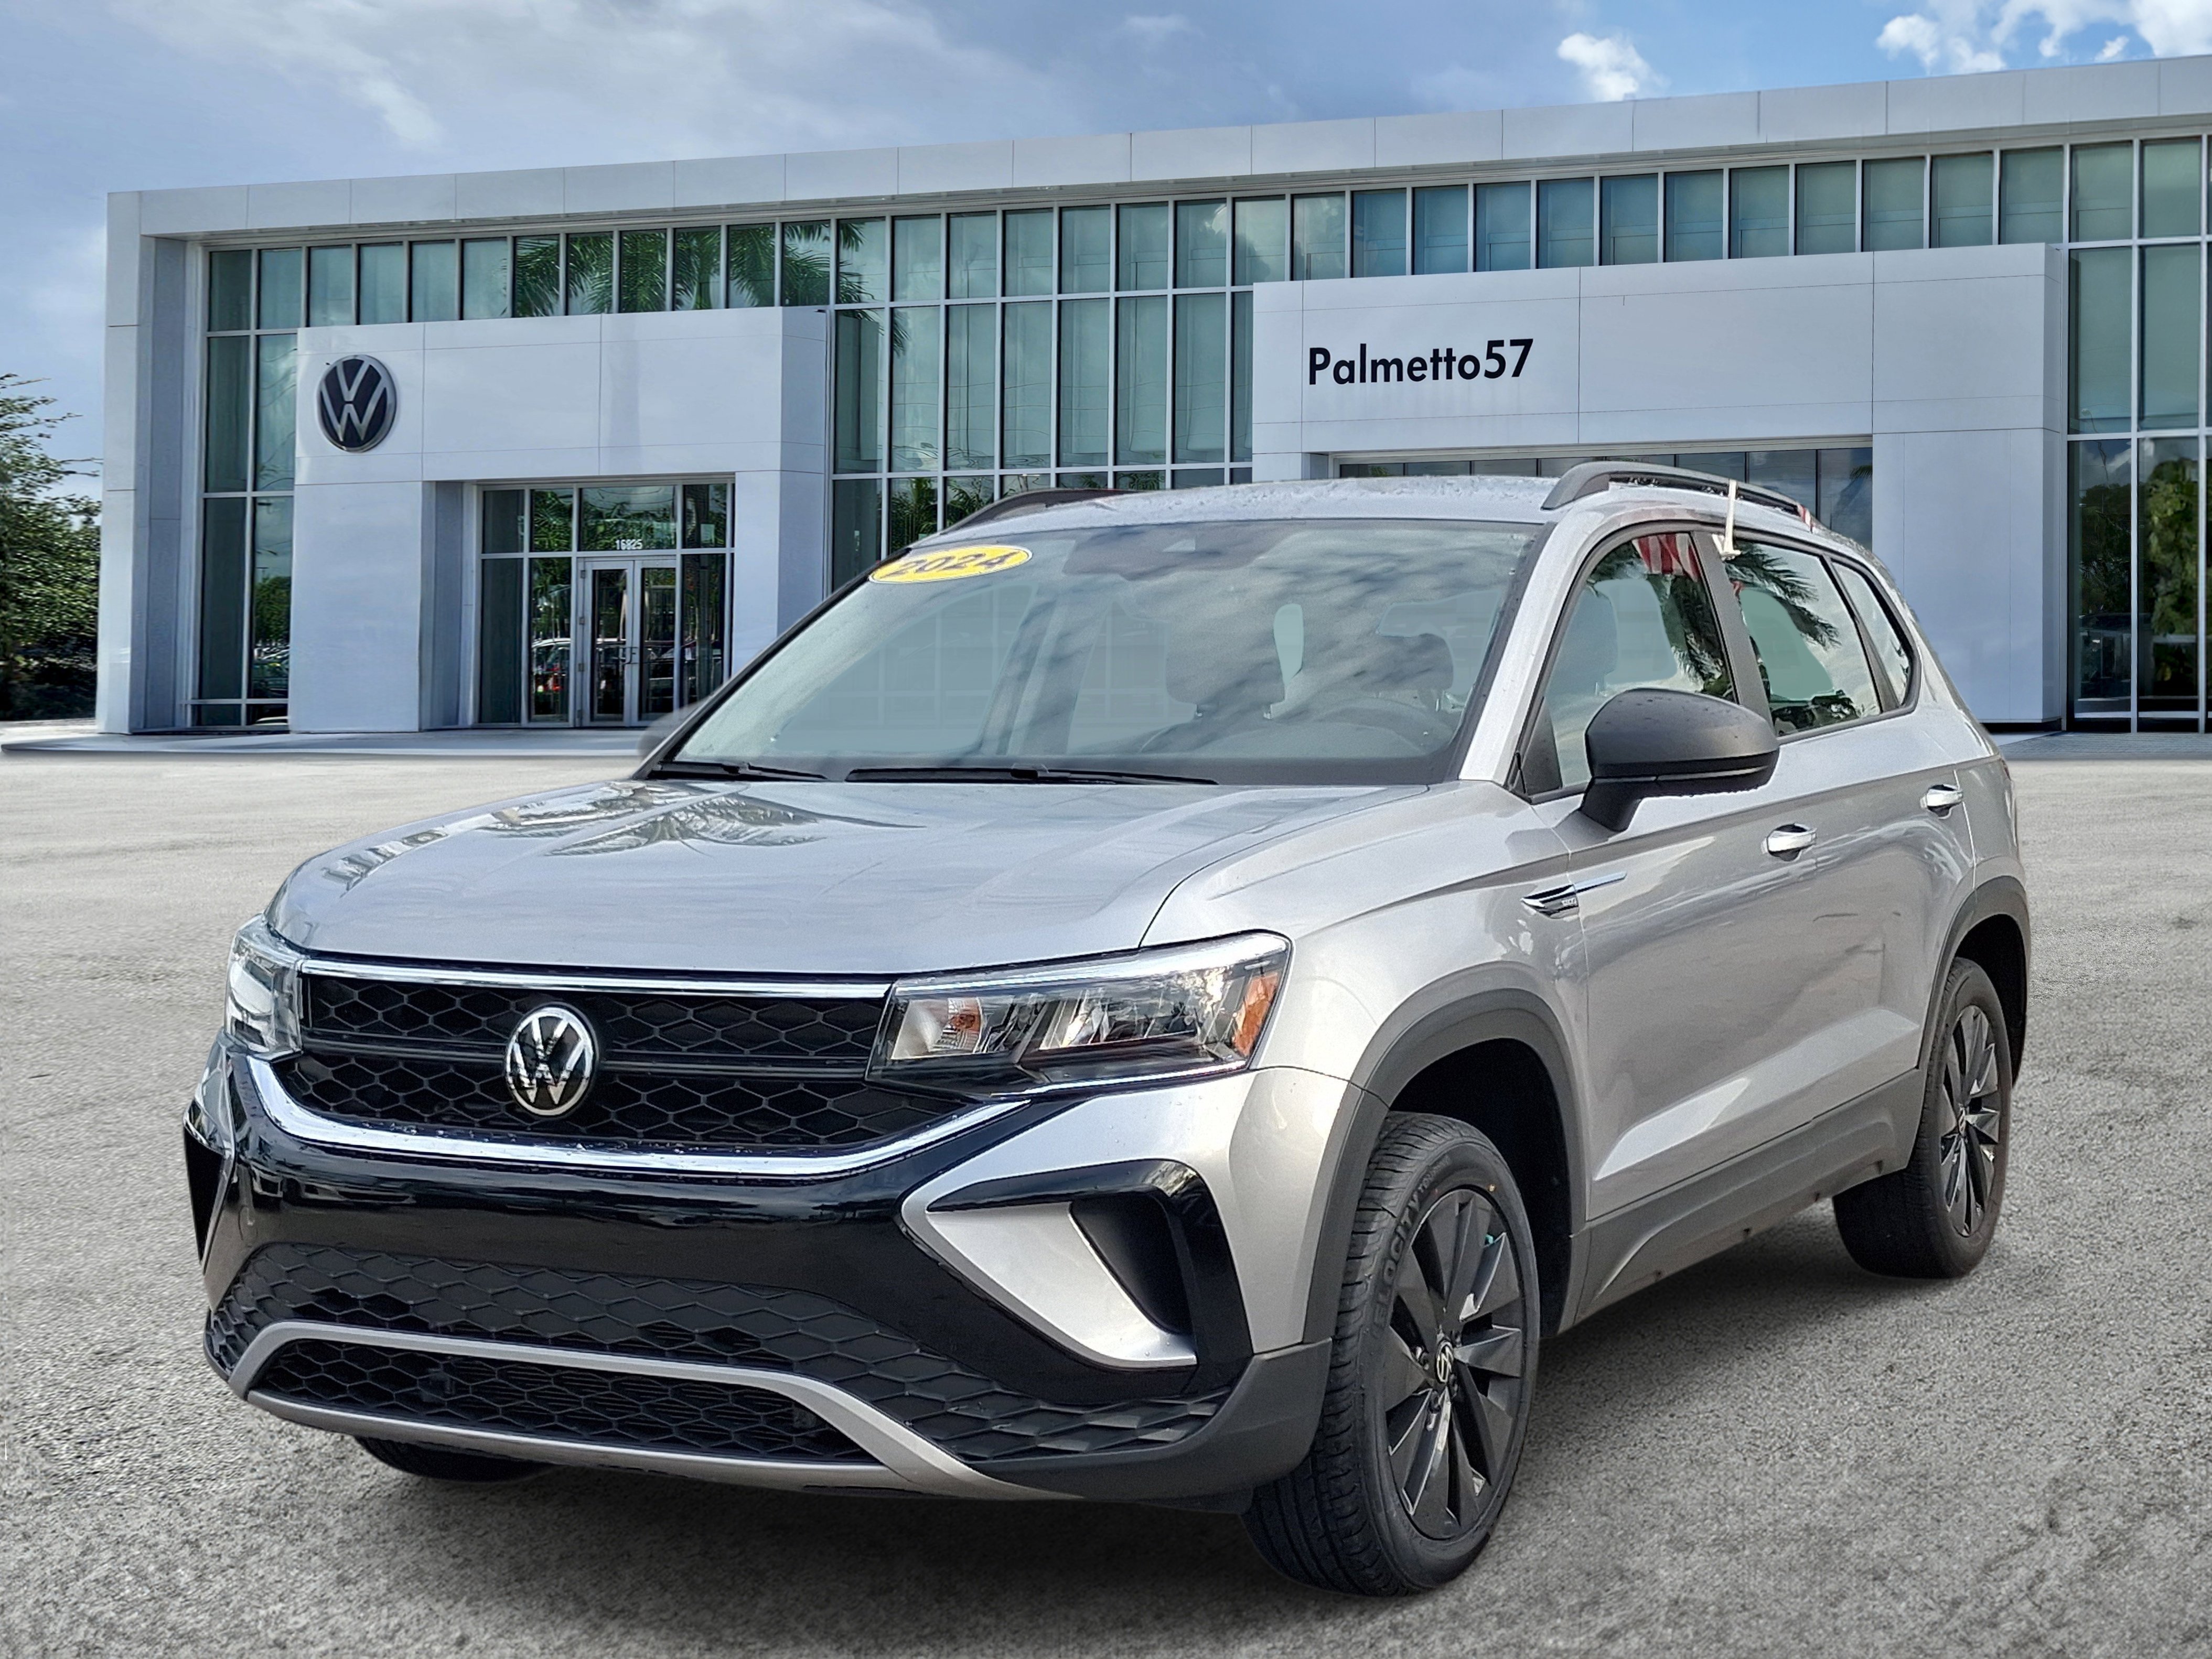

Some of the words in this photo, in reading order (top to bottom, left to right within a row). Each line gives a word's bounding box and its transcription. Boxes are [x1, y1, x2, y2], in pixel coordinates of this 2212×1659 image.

[1309, 339, 1533, 385] Palmetto57
[318, 357, 393, 449] VW
[879, 551, 1021, 579] 2024
[509, 1008, 593, 1112] VW
